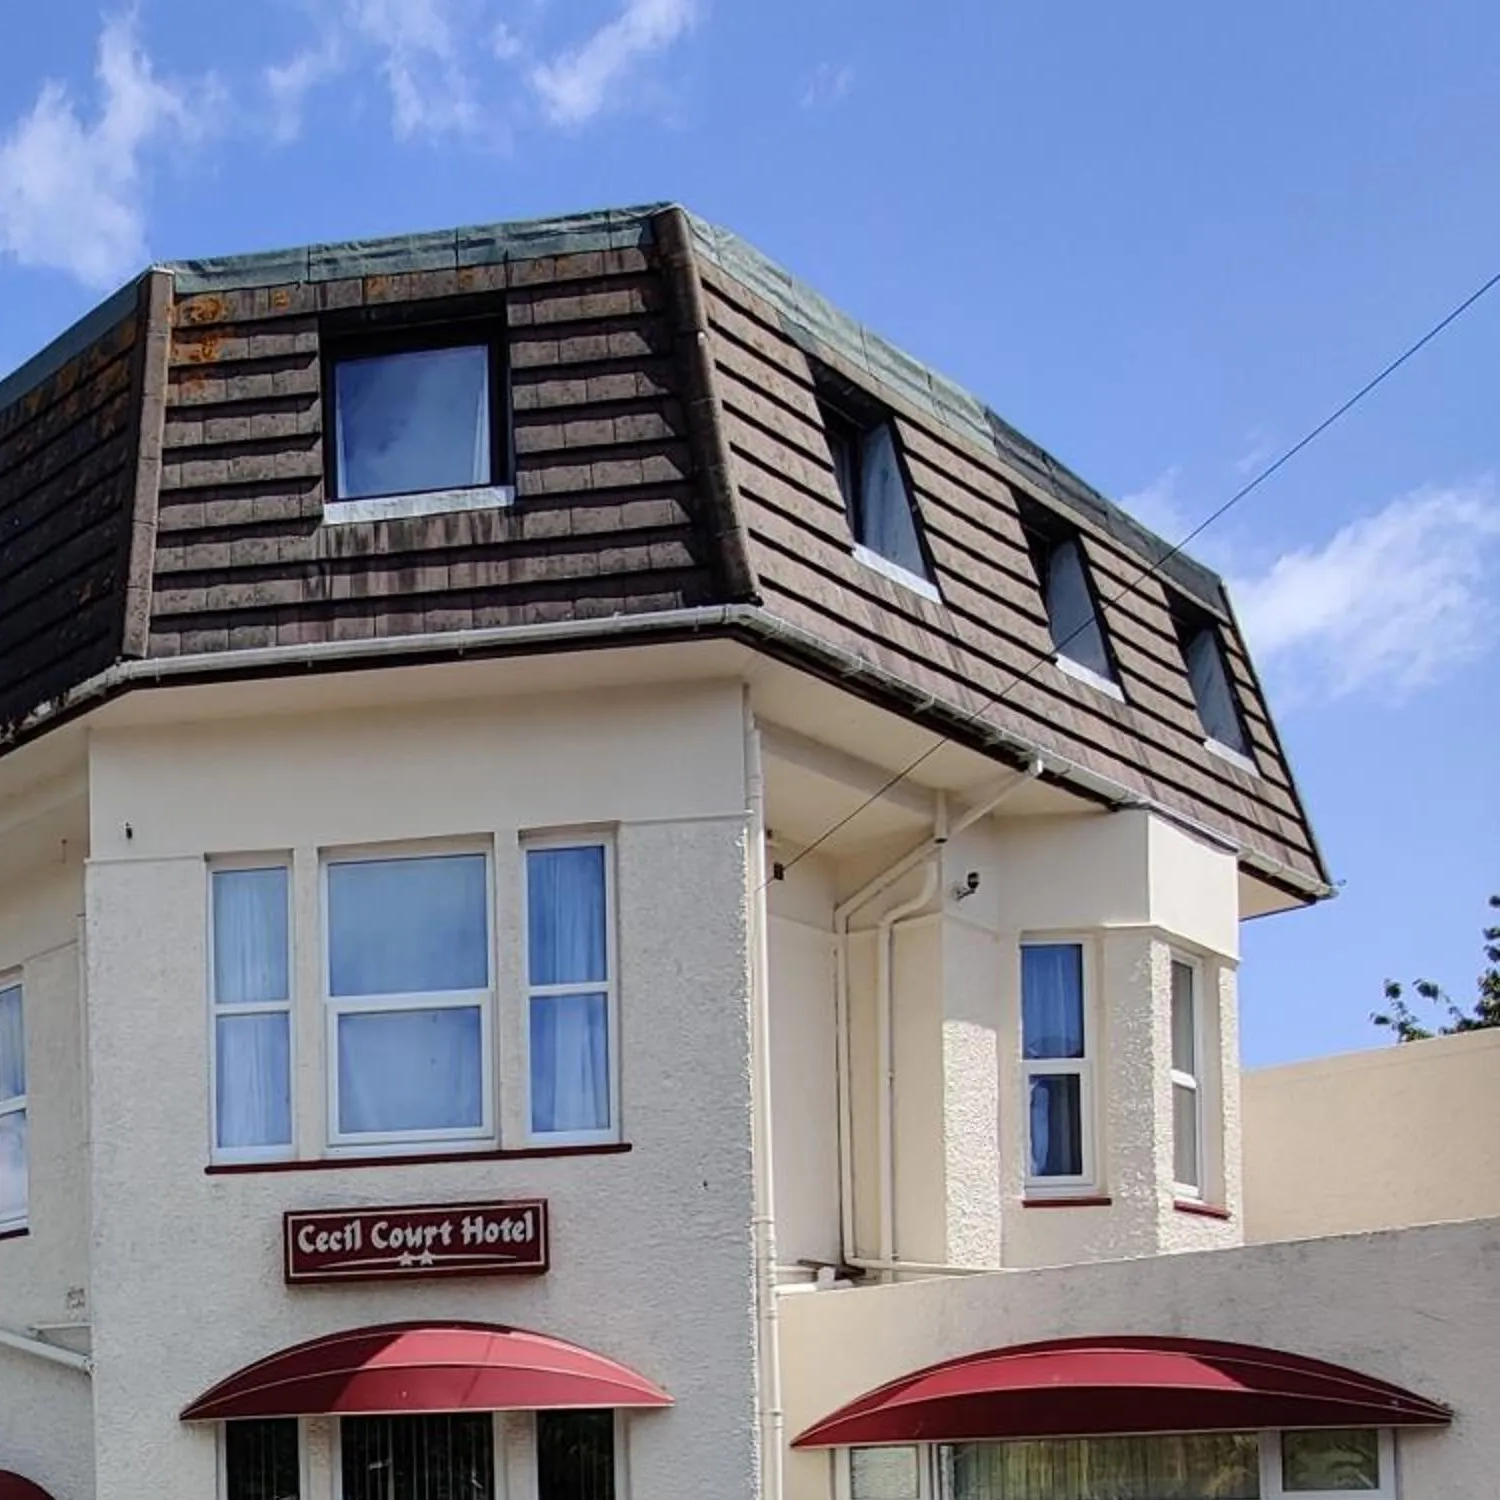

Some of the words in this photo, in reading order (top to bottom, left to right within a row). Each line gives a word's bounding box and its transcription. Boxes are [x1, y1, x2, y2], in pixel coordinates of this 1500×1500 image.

[298, 1218, 362, 1253] Cecil
[371, 1219, 452, 1249] Court
[461, 1210, 534, 1245] Hotel
